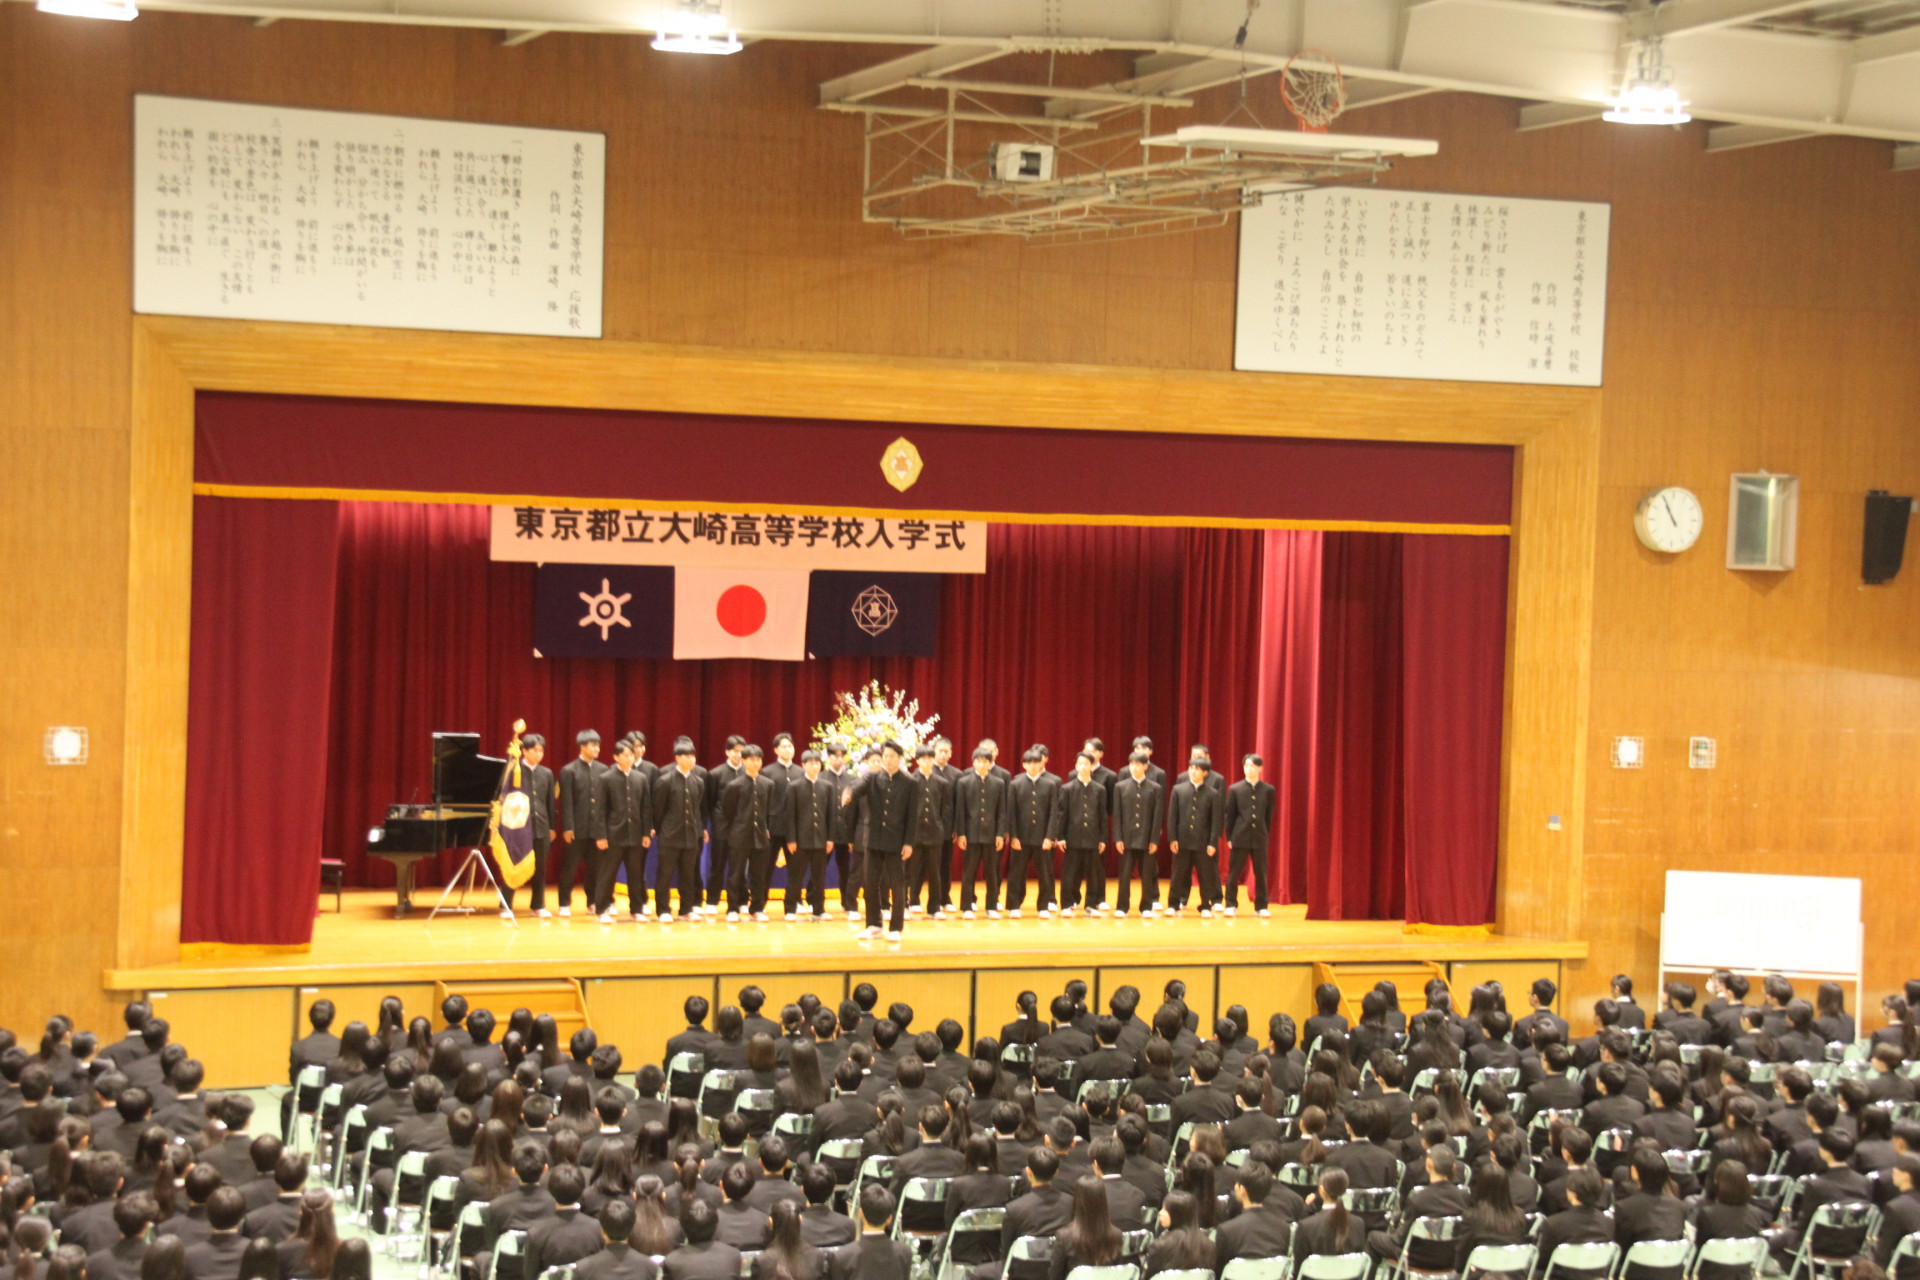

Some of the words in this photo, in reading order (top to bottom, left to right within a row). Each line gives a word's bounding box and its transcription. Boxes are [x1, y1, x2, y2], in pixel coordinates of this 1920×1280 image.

[157, 127, 168, 160] われら
[169, 128, 182, 161] われら
[182, 127, 194, 194] 顔を上げよう
[296, 139, 308, 171] われら
[308, 138, 320, 203] 顔を上げよう
[418, 148, 429, 180] われら
[156, 173, 168, 196] 大崎
[168, 174, 181, 197] 大崎
[295, 184, 307, 206] 大崎
[429, 148, 441, 212] 顔を上げよう
[453, 150, 464, 216] 時は流れても
[489, 154, 499, 196] どんなに
[207, 203, 218, 244] 心の中に
[416, 193, 428, 215] 大崎
[570, 143, 582, 274] 東京都立大崎高等学校
[1292, 193, 1305, 241] 健やかに
[1324, 195, 1334, 255] たゆみなし
[1355, 200, 1367, 257] いざや共に
[1388, 200, 1400, 258] ゆたかなり
[155, 208, 168, 264] 誇りを胸に
[168, 209, 181, 264] 誇りを胸に
[294, 218, 306, 273] 誇りを胸に
[332, 224, 344, 264] 心の中に
[416, 227, 427, 281] 誇りを胸に
[452, 231, 463, 272] 心の中に
[476, 230, 487, 274] 友がいる
[1449, 204, 1461, 321] 友情のあふるるところ
[1480, 206, 1493, 276] みどり新たに
[1531, 281, 1541, 305] 作曲
[1546, 282, 1557, 306] 作詞
[1571, 211, 1586, 334] 東京都立大崎高等学校
[568, 290, 580, 327] 応援歌
[1273, 279, 1284, 352] 進みゆくべし
[1289, 256, 1300, 350] よろこび満ちたり
[1320, 269, 1331, 354] 自治のこころよ
[1351, 272, 1363, 341] 自由と知性の
[1384, 273, 1396, 345] 若きいのちよ
[1568, 349, 1579, 373] 校歌
[514, 506, 966, 551] 東京都立大崎高等学校入学式
